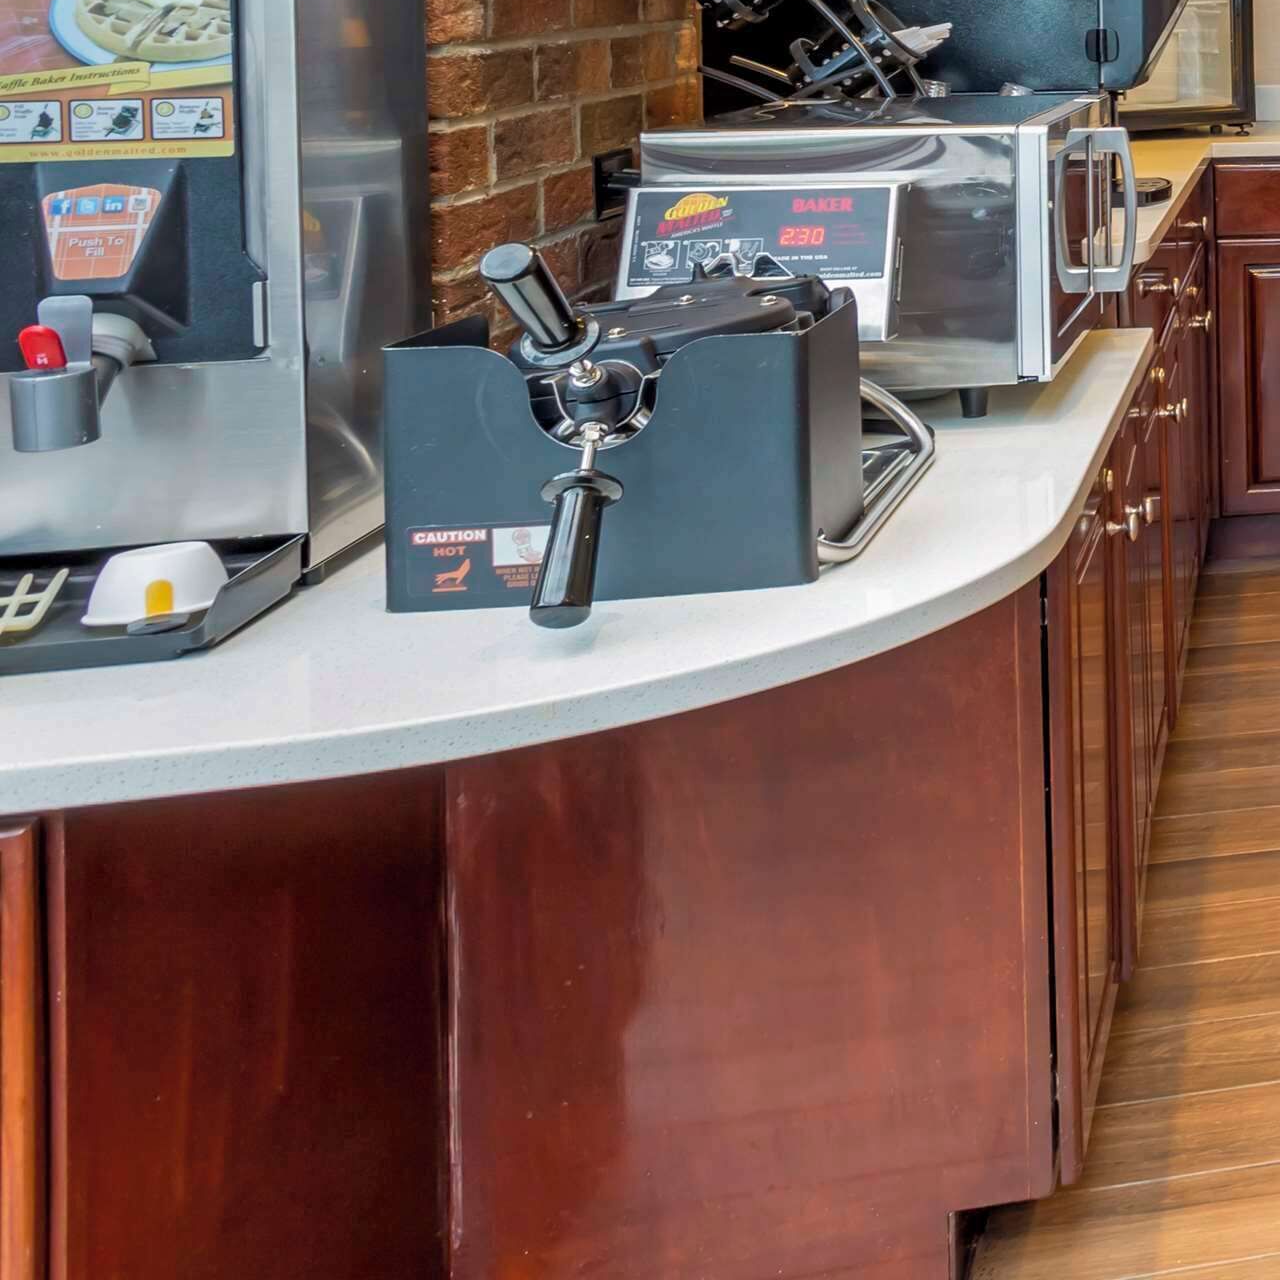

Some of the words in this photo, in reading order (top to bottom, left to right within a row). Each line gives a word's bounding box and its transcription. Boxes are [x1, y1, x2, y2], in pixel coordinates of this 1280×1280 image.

[30, 75, 67, 87] Baker
[68, 67, 141, 83] Instructions
[28, 145, 188, 159] www.goldenmalted.com
[791, 197, 854, 214] BAKER
[68, 237, 104, 248] Push
[107, 236, 126, 246] To
[779, 226, 825, 247] 2:30
[84, 246, 105, 258] Fill
[413, 529, 487, 544] CAUTION
[433, 545, 466, 557] HOT
